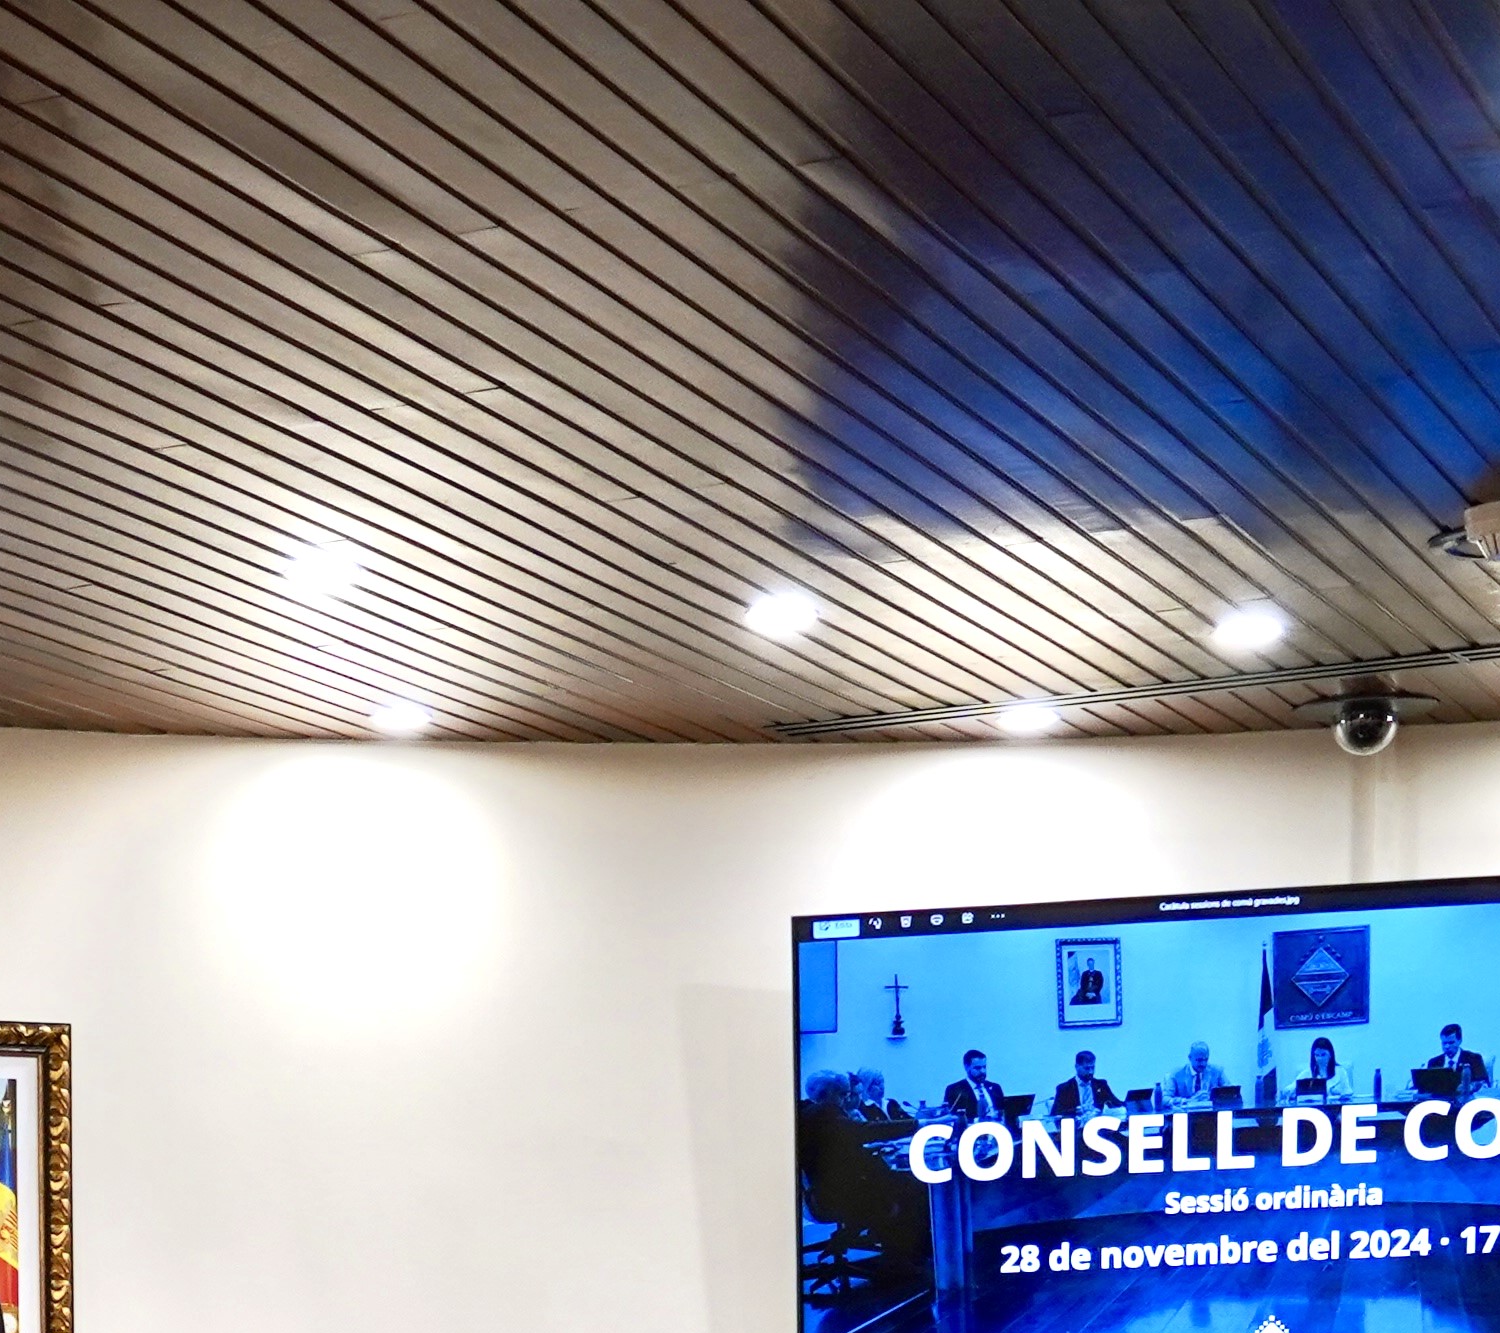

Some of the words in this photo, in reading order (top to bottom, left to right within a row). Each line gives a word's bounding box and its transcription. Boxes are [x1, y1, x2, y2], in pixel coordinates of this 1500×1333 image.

[908, 1110, 1255, 1184] CONSELL
[1282, 1103, 1378, 1166] DE
[1164, 1187, 1249, 1215] Sessió
[1256, 1182, 1383, 1211] ordinària
[1000, 1244, 1041, 1274] 28
[1048, 1241, 1092, 1272] de
[1100, 1234, 1279, 1270] novembre
[1286, 1229, 1340, 1262] del
[1349, 1227, 1432, 1259] 2024
[1460, 1225, 1500, 1255] 17
